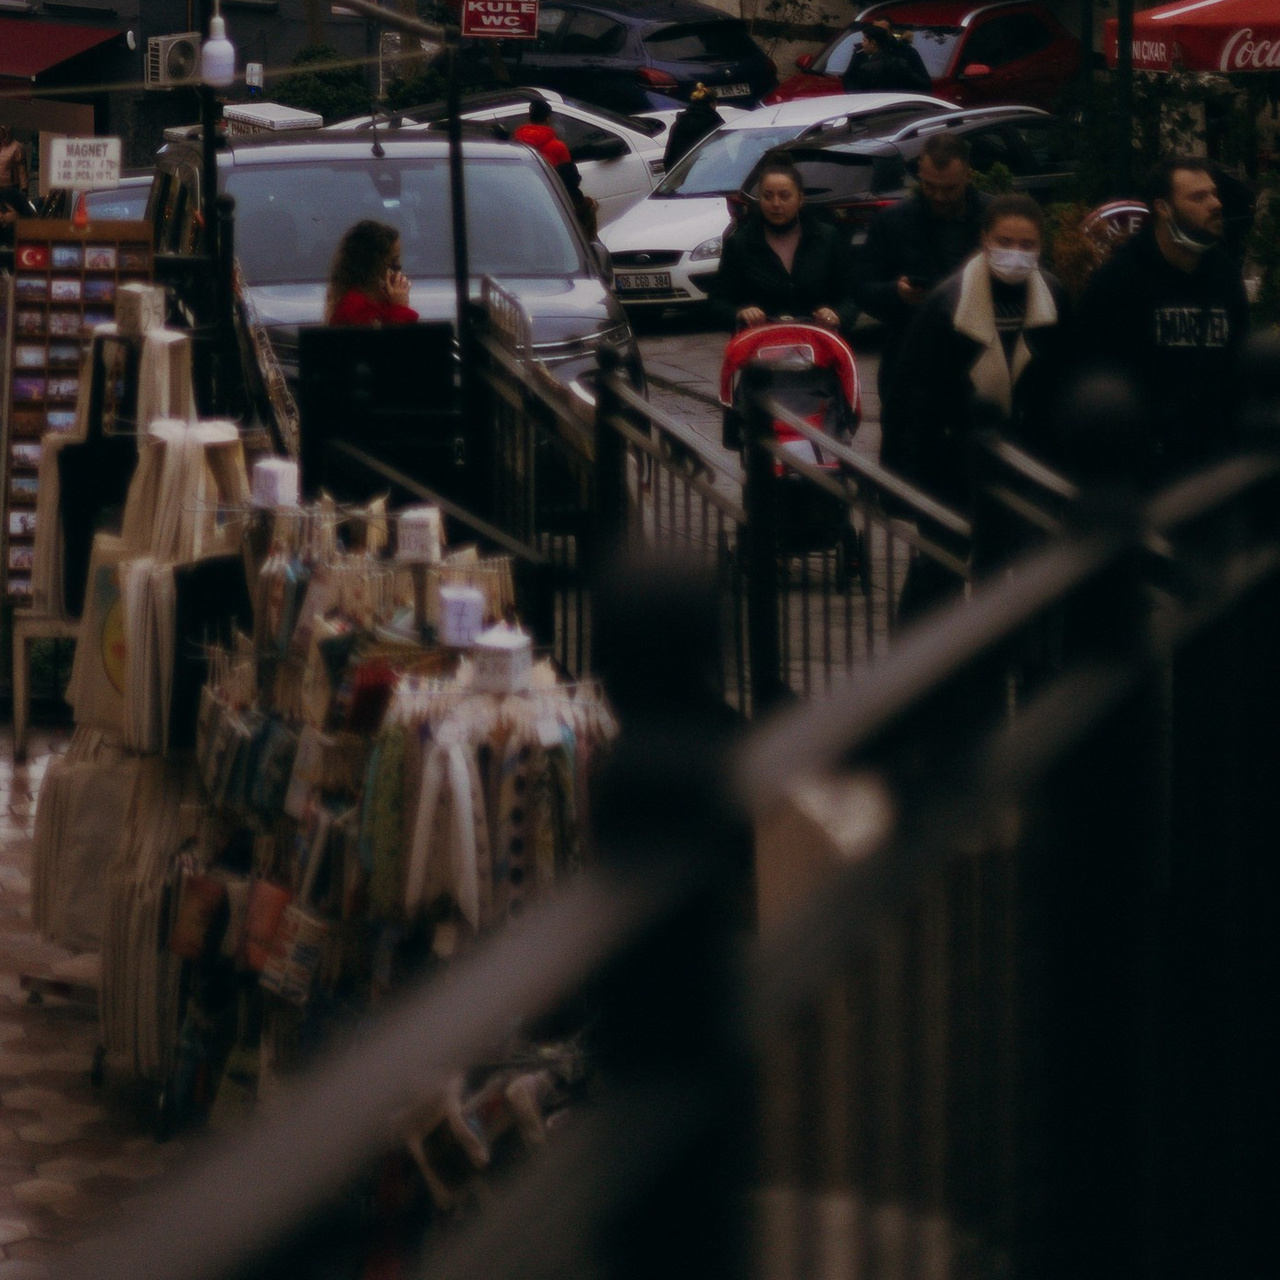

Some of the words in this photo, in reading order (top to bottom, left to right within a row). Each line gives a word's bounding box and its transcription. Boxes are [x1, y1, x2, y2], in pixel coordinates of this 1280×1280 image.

[468, 1, 536, 13] KULE
[481, 15, 521, 27] WC
[1142, 41, 1167, 64] ÇIKAR
[66, 143, 108, 157] MAGNET
